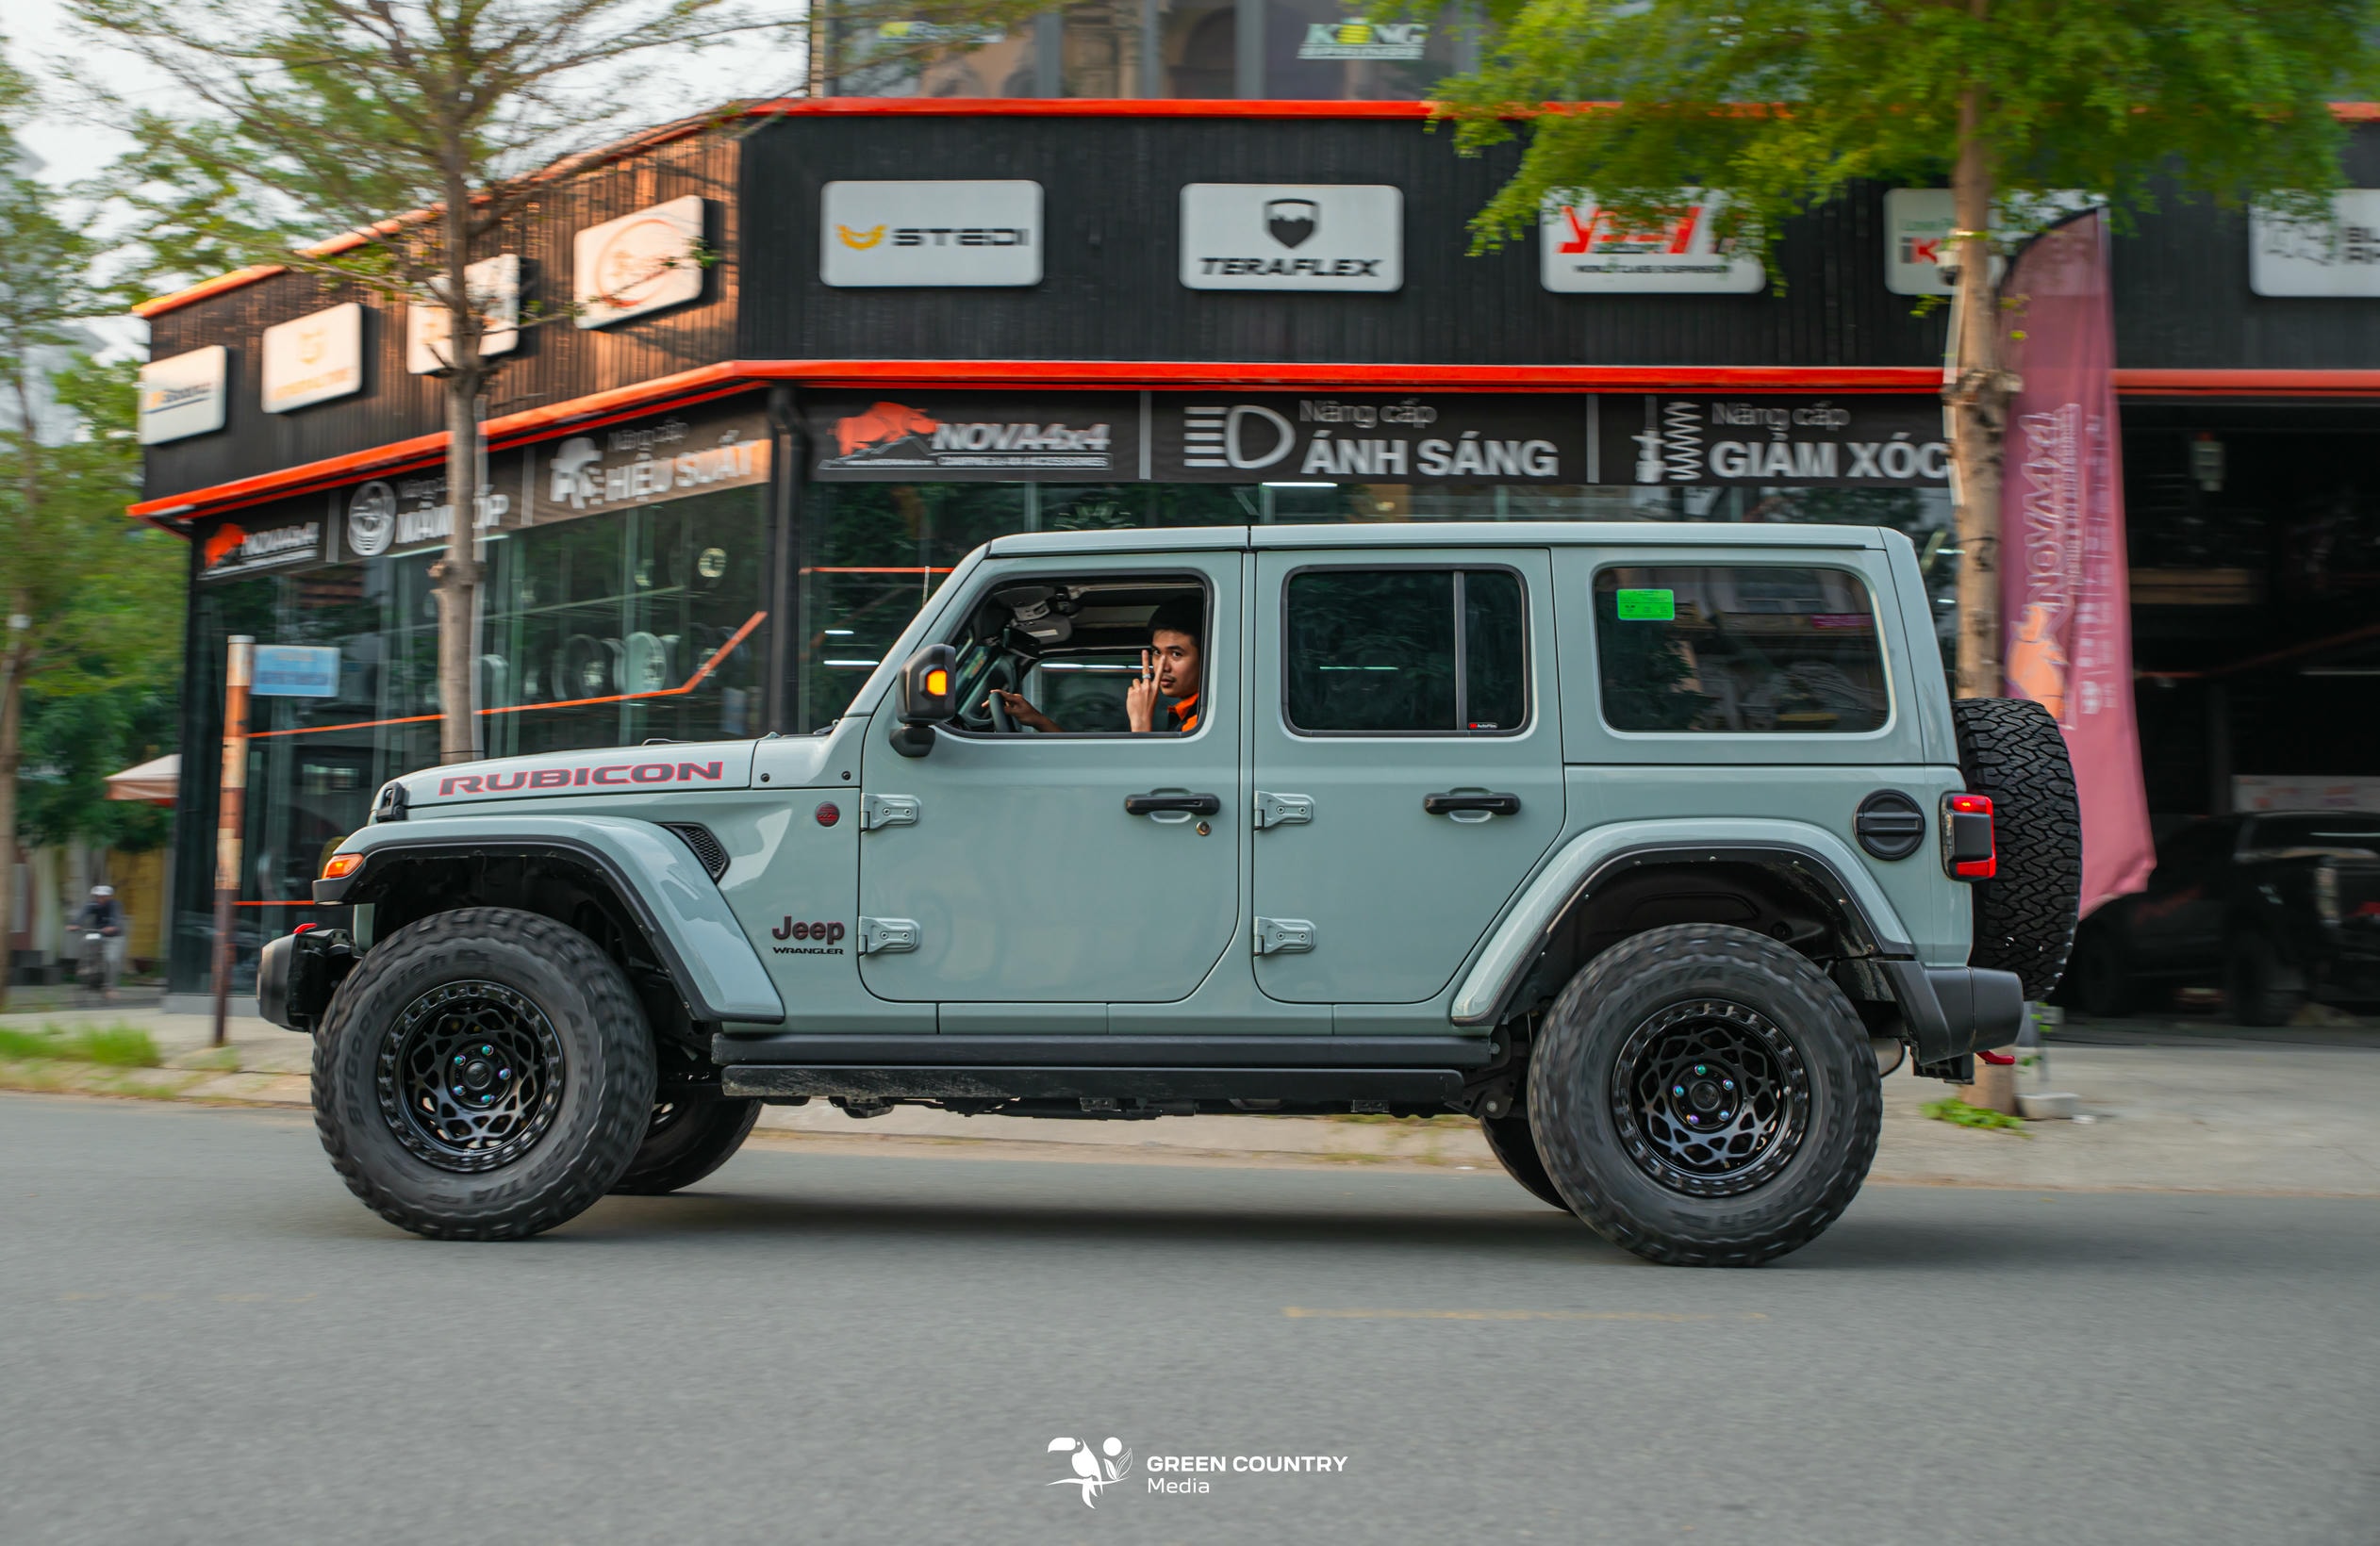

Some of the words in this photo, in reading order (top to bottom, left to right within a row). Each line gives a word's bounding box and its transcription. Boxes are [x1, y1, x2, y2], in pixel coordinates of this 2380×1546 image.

[891, 228, 1030, 246] STEDI
[1198, 257, 1383, 276] TERAFLEX
[1299, 399, 1378, 428] Nâng
[1380, 398, 1438, 428] cấp
[1711, 403, 1790, 431] Nâng
[1793, 401, 1850, 431] cấp
[931, 423, 1110, 451] NOVA4x4
[1300, 430, 1409, 474] ÁNH
[1417, 431, 1559, 475] SÁNG
[1709, 433, 1838, 477] GIẢM
[1845, 432, 1953, 479] XÓC
[438, 761, 723, 797] RUBICON
[772, 916, 845, 946] Jeep
[772, 946, 844, 956] WRANGLER
